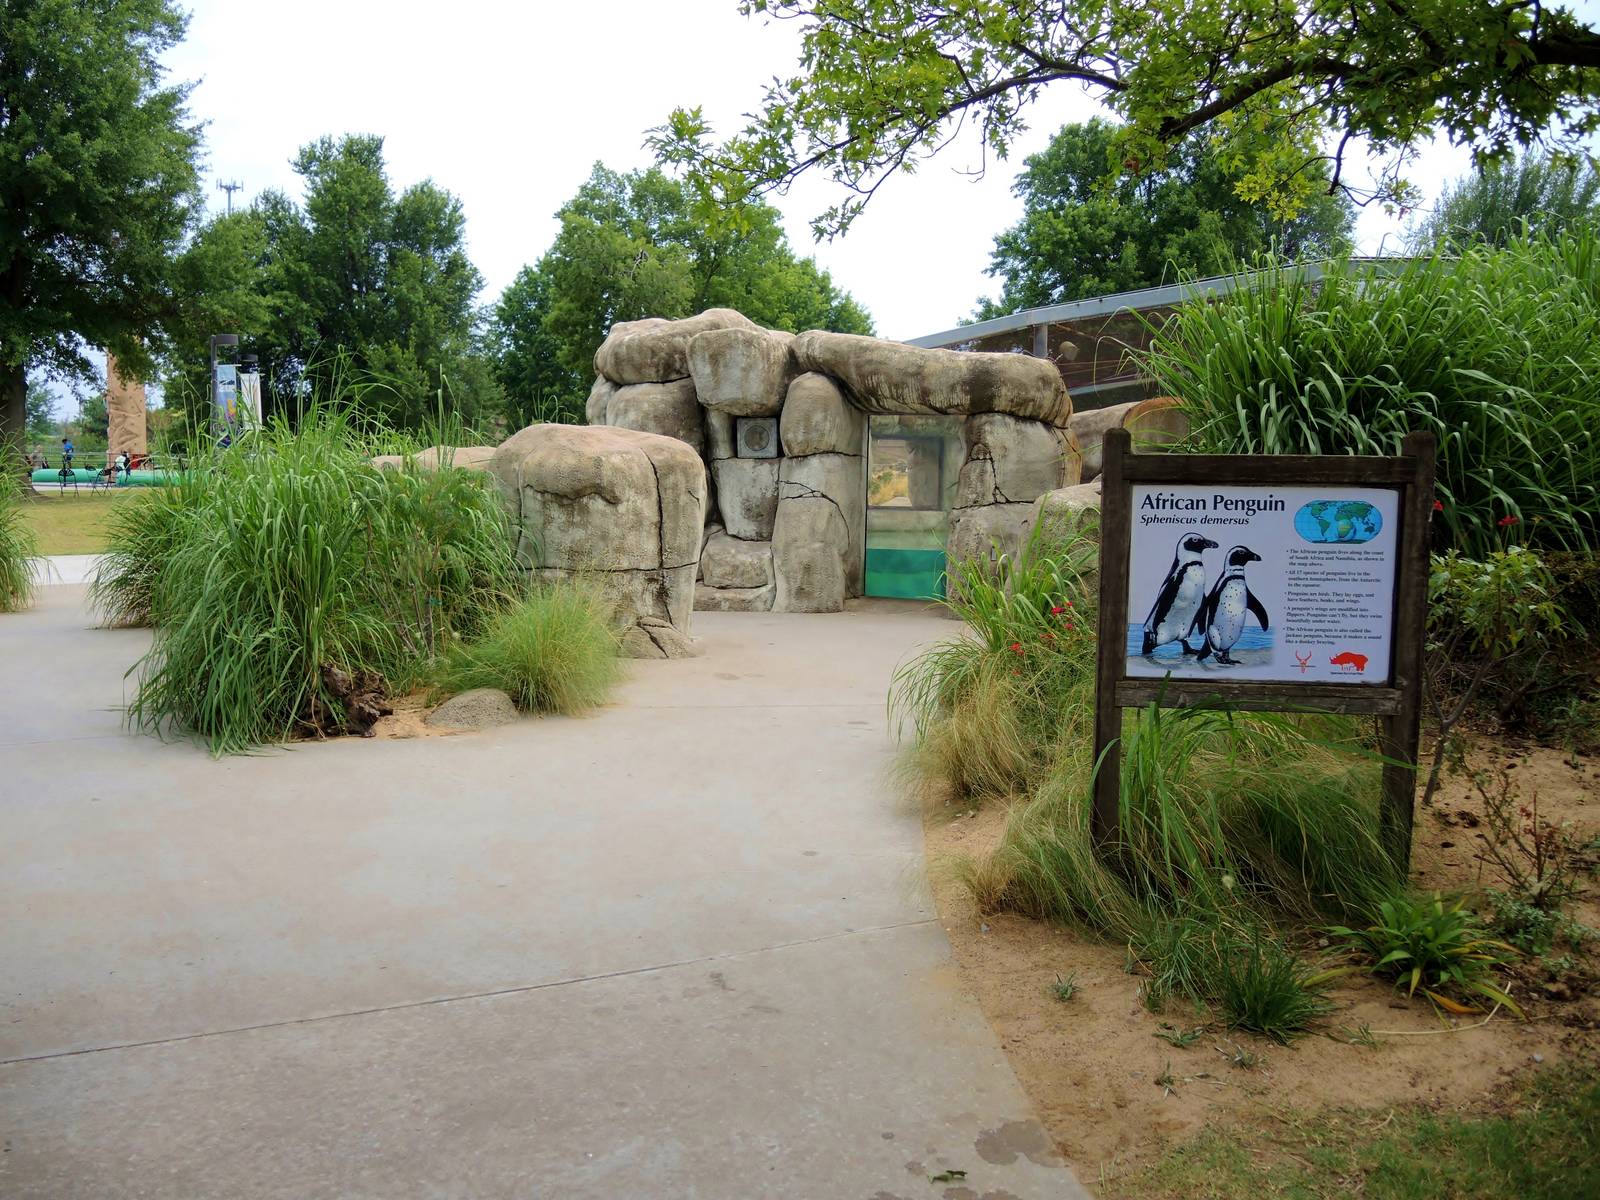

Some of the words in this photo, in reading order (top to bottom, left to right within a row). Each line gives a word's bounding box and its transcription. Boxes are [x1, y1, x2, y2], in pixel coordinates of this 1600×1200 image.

[1141, 493, 1207, 510] African
[1213, 494, 1285, 516] Penguin
[1140, 514, 1197, 526] Spheniscus
[1200, 515, 1249, 525] demersus
